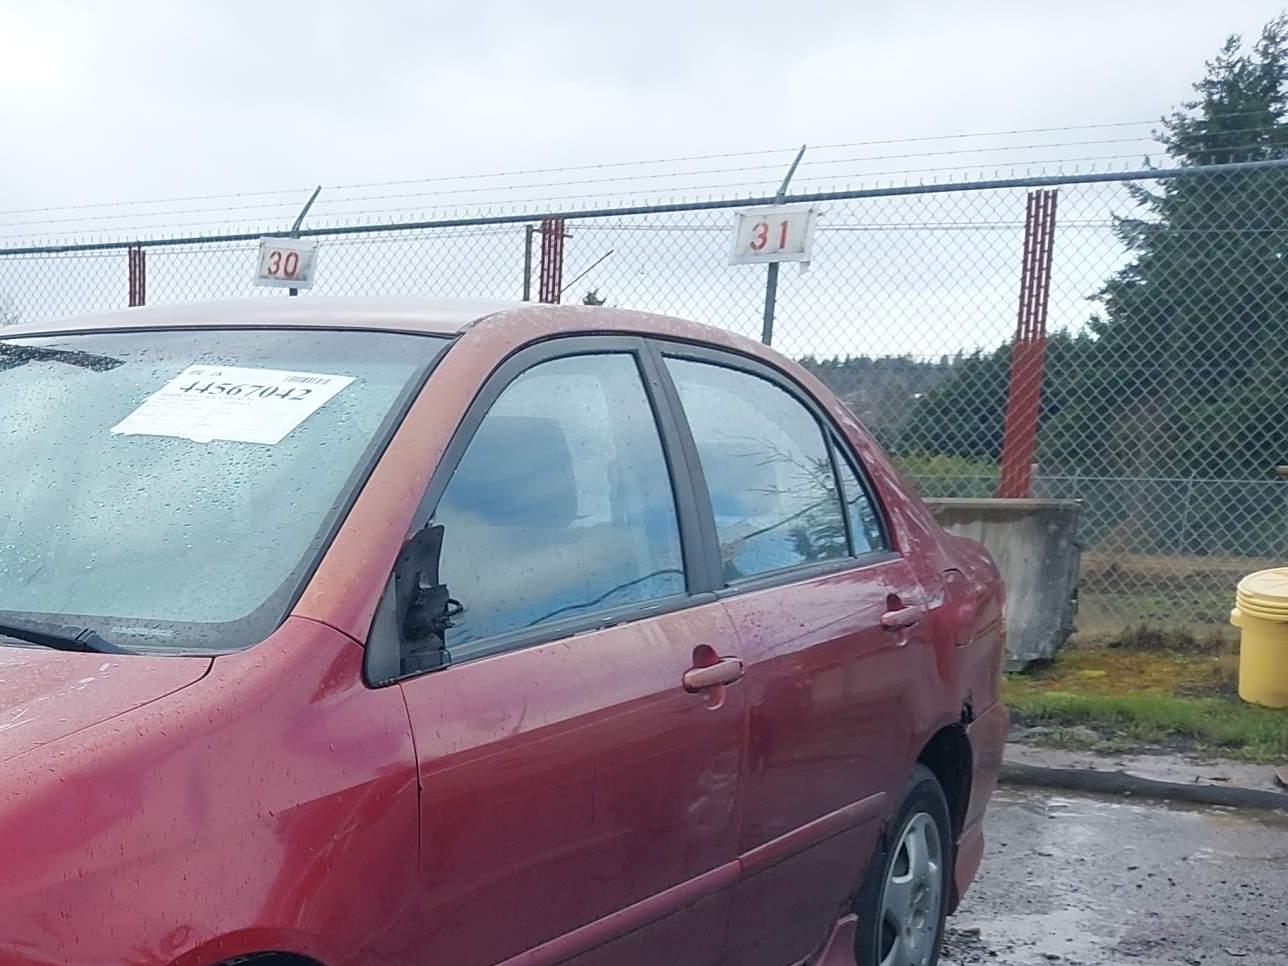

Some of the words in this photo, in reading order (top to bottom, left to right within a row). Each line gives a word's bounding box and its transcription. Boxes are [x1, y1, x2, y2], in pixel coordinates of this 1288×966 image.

[750, 221, 788, 251] 31
[268, 251, 299, 278] 30
[179, 380, 312, 401] 44567042
